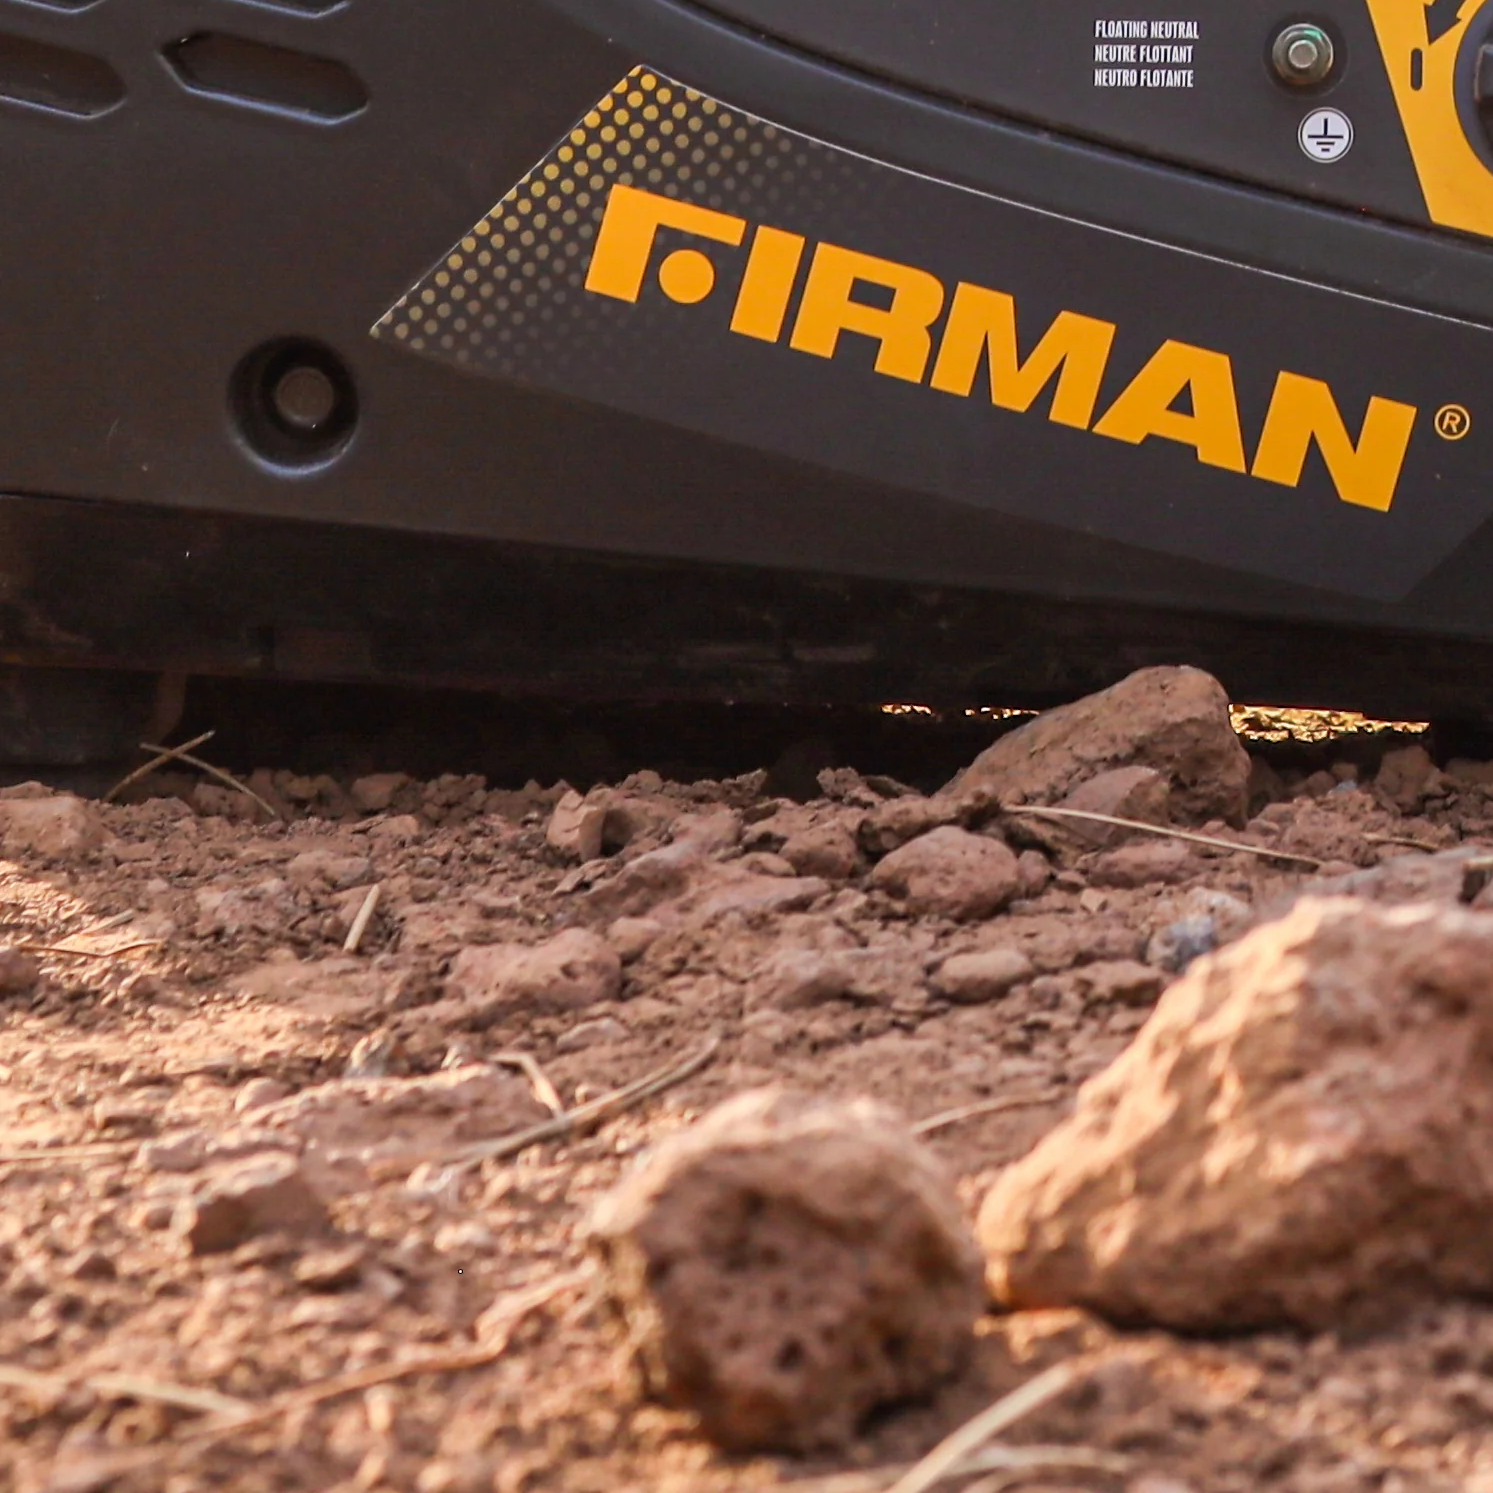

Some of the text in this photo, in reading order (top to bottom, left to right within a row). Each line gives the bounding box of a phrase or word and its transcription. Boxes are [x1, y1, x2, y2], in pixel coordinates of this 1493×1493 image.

[1094, 20, 1200, 40] FLOATING NEUTRAL
[1094, 44, 1193, 64] NEUTRE FLOTTANT
[1093, 69, 1194, 88] NEUTRO FLOTANTE
